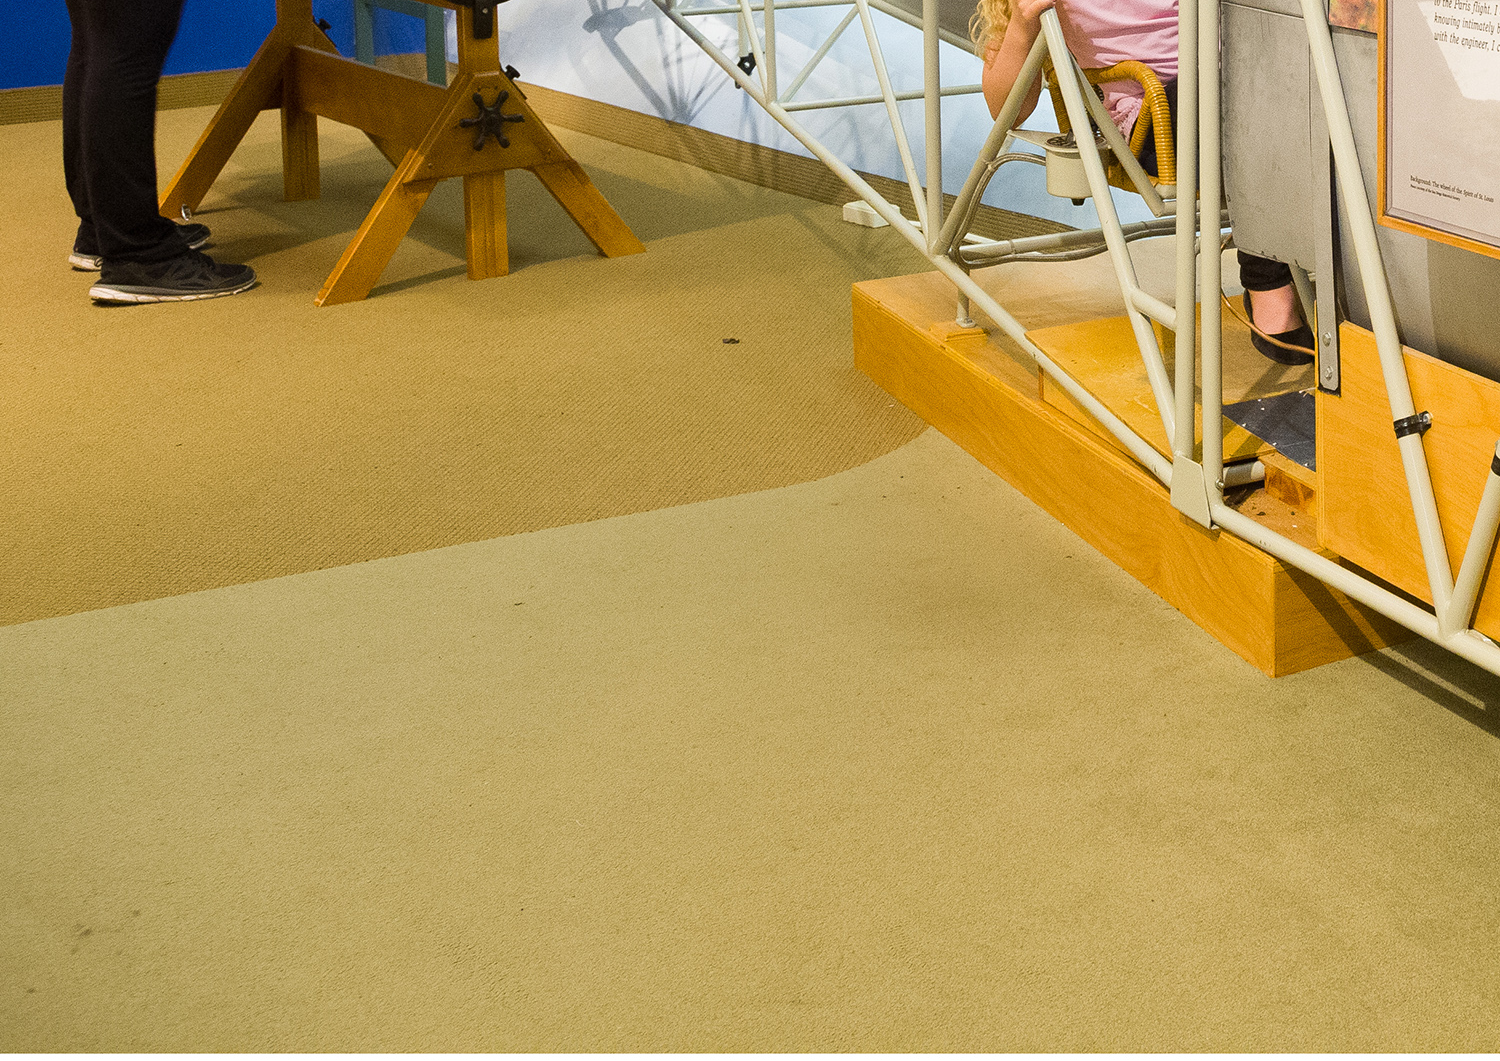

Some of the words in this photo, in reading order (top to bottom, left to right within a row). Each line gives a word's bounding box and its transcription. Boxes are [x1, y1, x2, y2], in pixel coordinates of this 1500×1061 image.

[1494, 4, 1498, 16] I
[1434, 12, 1460, 28] knowing
[1462, 17, 1494, 35] intimately
[1434, 31, 1448, 42] with
[1450, 33, 1459, 44] the
[1461, 35, 1489, 52] engineer,
[1491, 40, 1495, 51] I
